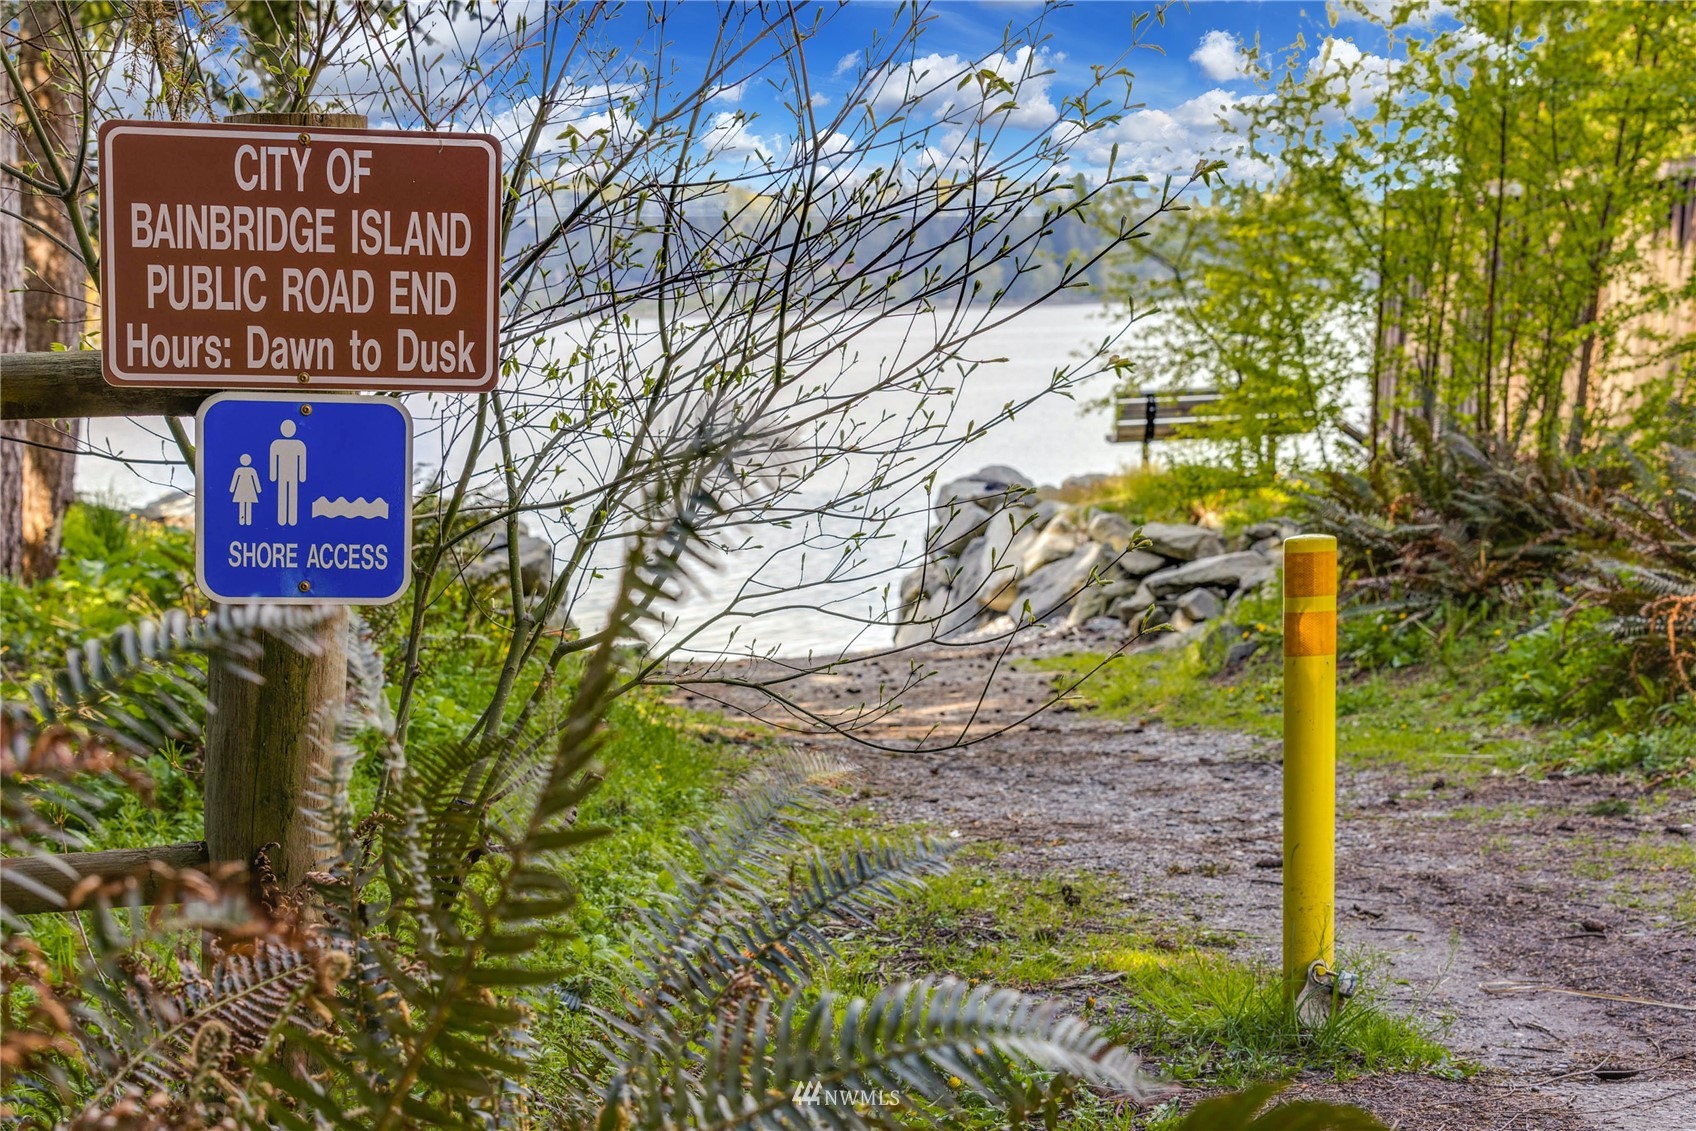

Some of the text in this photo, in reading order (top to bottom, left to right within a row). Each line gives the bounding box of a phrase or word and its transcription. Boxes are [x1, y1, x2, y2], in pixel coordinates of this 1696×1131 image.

[234, 144, 373, 194] CITY OF
[131, 203, 472, 257] BAINBRIDGE ISLAND
[147, 264, 457, 316] PUBLIC ROAD END
[126, 323, 476, 374] Hours: Dawn to Dusk
[228, 541, 388, 570] SHORE ACCESS
